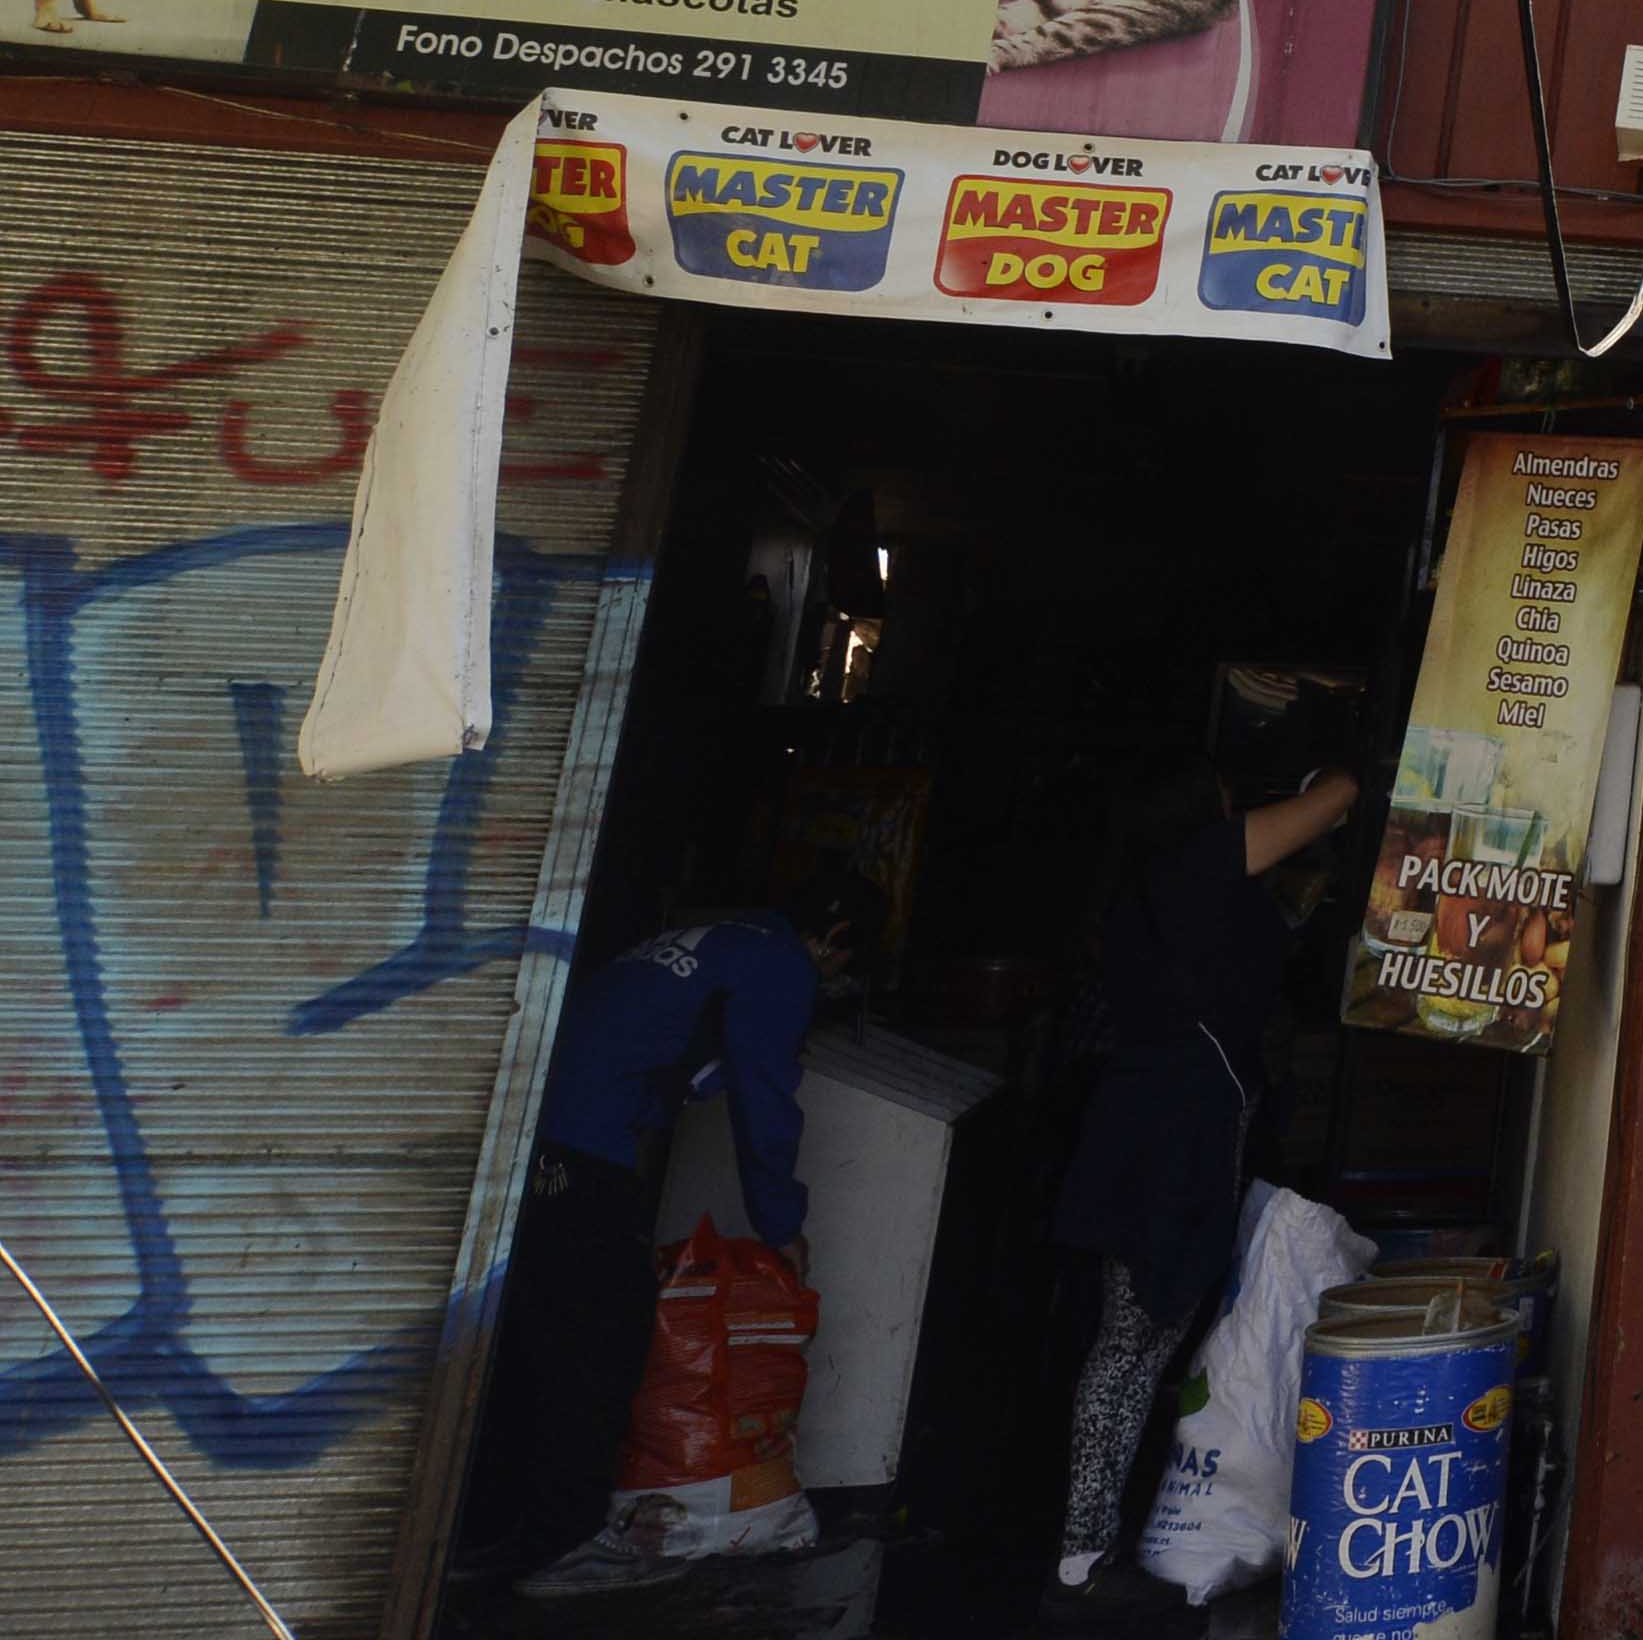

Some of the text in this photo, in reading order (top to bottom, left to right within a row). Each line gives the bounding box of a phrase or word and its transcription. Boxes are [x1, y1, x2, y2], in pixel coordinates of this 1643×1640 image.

[397, 26, 849, 89] Fono Despachos 291 3345
[721, 126, 774, 147] CAT
[993, 149, 1050, 172] DOG
[1256, 164, 1304, 184] CAT
[673, 165, 890, 218] MASTER
[953, 188, 1160, 235] MASTER
[726, 229, 820, 274] CAT
[985, 252, 1105, 293] DOG
[1255, 265, 1348, 306] CAT
[1513, 453, 1619, 479] Almendras
[1526, 484, 1596, 509] Nueces
[1525, 515, 1582, 539] Pasas
[1521, 545, 1578, 573] Higos
[1511, 576, 1576, 603] Linaza
[1515, 607, 1560, 633] Chia
[1496, 636, 1570, 666] Quinoa
[1486, 668, 1569, 697] Sesamo
[1498, 700, 1545, 728] Miel
[1397, 855, 1573, 909] PACK MOTE
[1466, 913, 1490, 948] Y
[1377, 953, 1549, 1009] HUESILLOS
[1370, 1426, 1450, 1448] PURINA
[1343, 1450, 1463, 1516] CAT
[1338, 1500, 1499, 1579] CHOW
[1335, 1606, 1378, 1624] Salud
